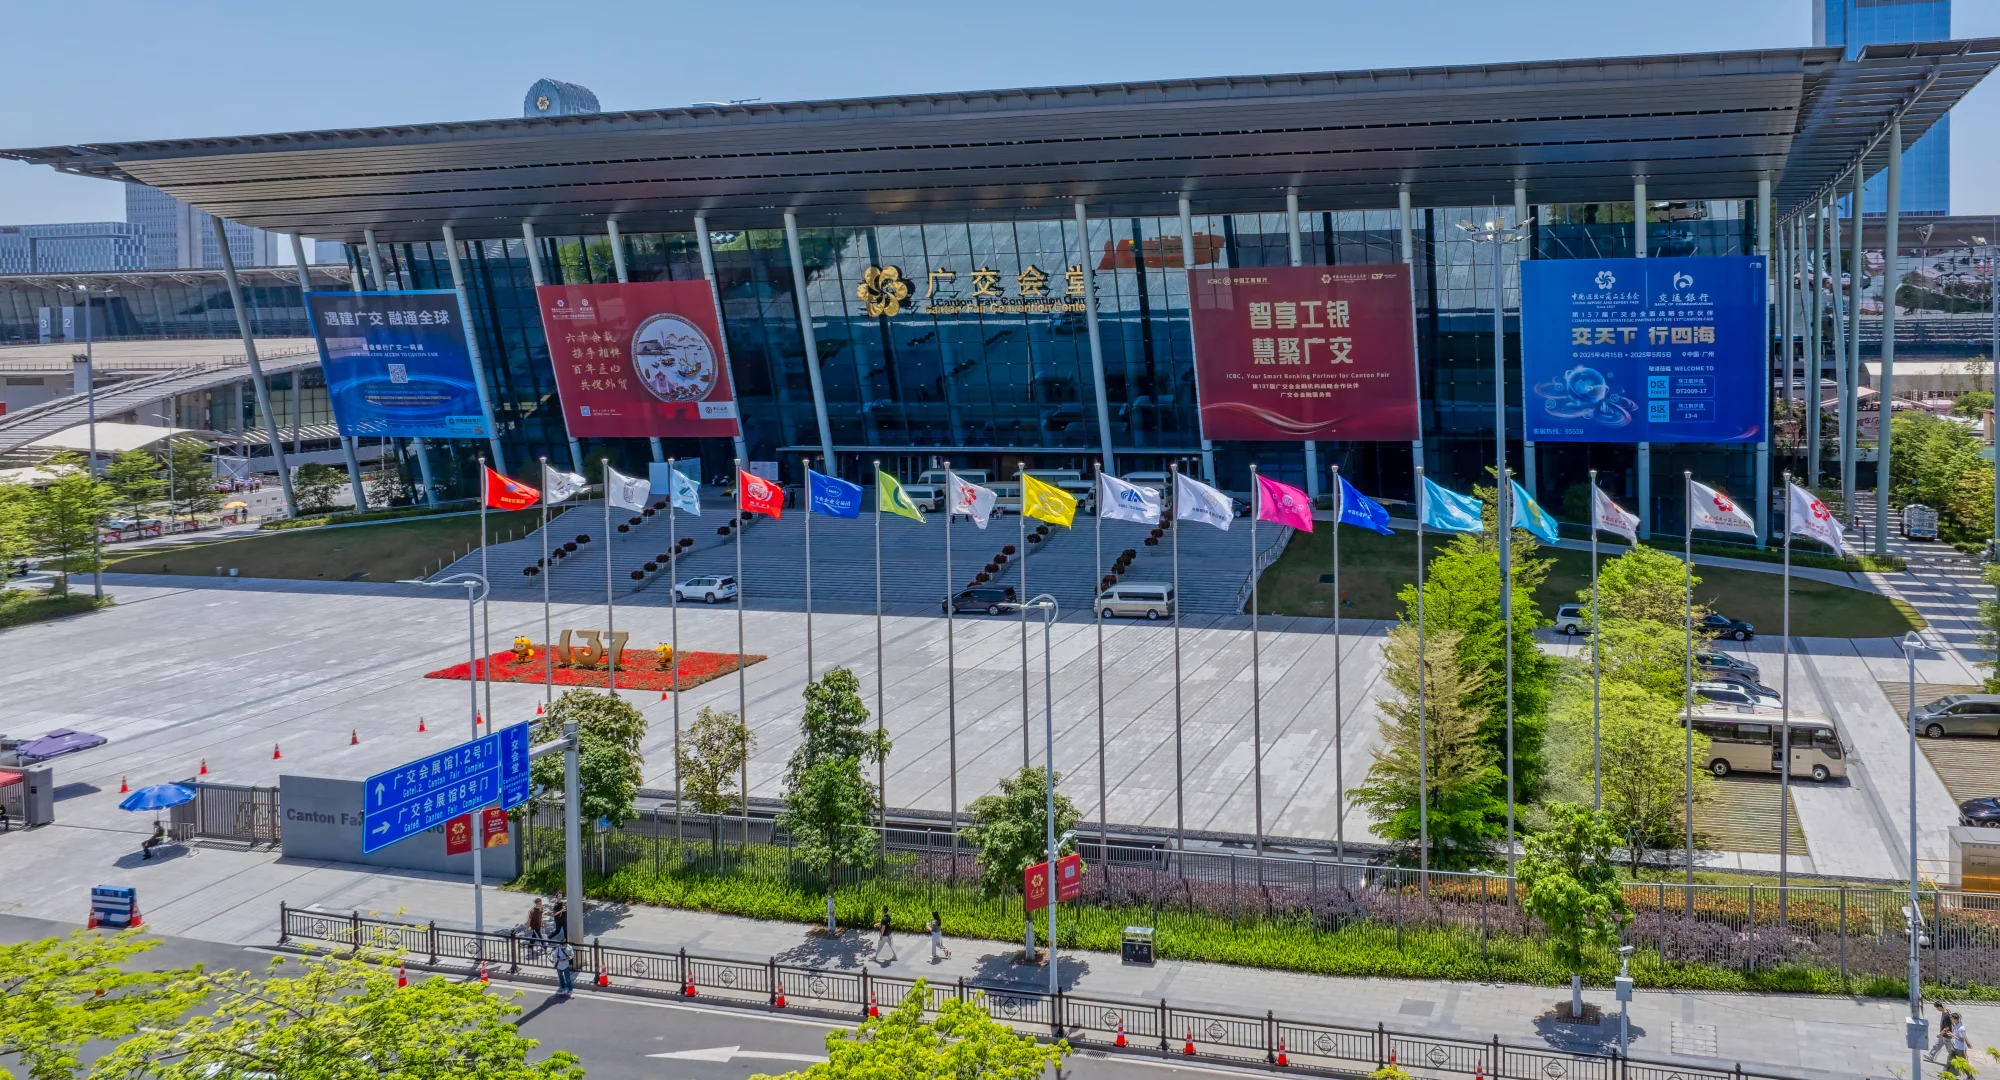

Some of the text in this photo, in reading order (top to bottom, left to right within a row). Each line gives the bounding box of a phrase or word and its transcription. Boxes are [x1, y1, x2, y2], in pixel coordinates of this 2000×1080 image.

[926, 264, 1086, 298] 广交会堂
[324, 309, 450, 326] 遇建广交 融通全球
[924, 302, 1086, 314] Canton Fair Convention Cente
[1249, 300, 1350, 329] 智享工银
[40, 320, 48, 328] 3
[64, 319, 71, 327] 2
[1572, 326, 1715, 345] 交天下 行四海
[1252, 336, 1353, 364] 慧聚广交
[1650, 380, 1666, 388] D区
[1650, 405, 1666, 413] B区
[559, 629, 629, 665] 137
[510, 728, 520, 774] 广交会堂
[394, 742, 492, 790] 广交会展馆1、2号门
[428, 776, 445, 788] Canton
[450, 770, 460, 780] Fair
[464, 761, 484, 774] Complex
[503, 775, 518, 785] Canton
[503, 777, 528, 790] Convention
[398, 776, 488, 823] 广交会展馆8号门
[287, 808, 335, 824] Canton
[426, 812, 443, 823] Canton
[448, 805, 457, 815] Fair
[462, 796, 482, 808] Complex
